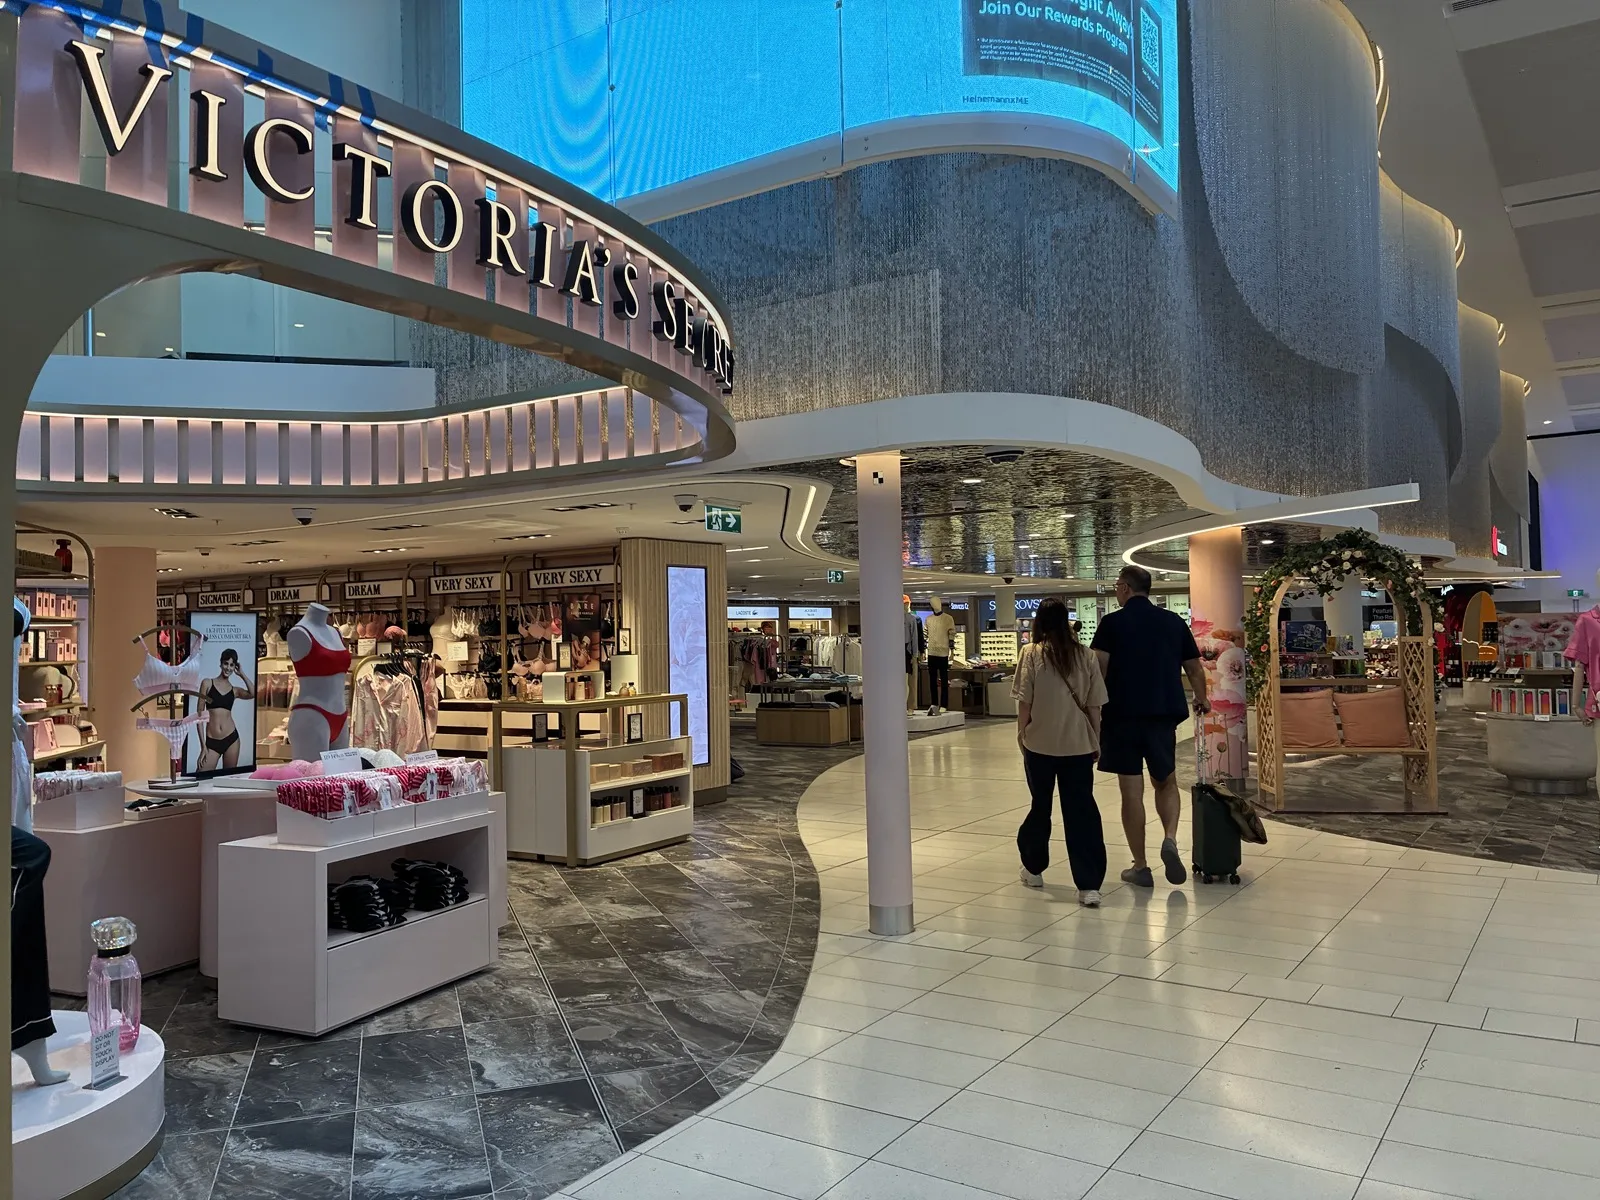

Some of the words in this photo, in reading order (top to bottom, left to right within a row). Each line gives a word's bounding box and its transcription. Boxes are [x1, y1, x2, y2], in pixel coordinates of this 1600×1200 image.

[979, 0, 1011, 15] Join
[1015, 2, 1042, 18] Our
[1045, 6, 1094, 33] Rewards
[1096, 22, 1128, 55] Program
[64, 39, 639, 320] VICTORIA'S
[652, 280, 734, 394] SECRE
[434, 578, 463, 592] VERY
[464, 576, 494, 590] SEXY
[534, 571, 566, 586] VERY
[569, 569, 603, 583] SEXY
[200, 592, 241, 605] SIGNATURE
[270, 589, 300, 601] DREAM
[348, 584, 380, 597] DREAM
